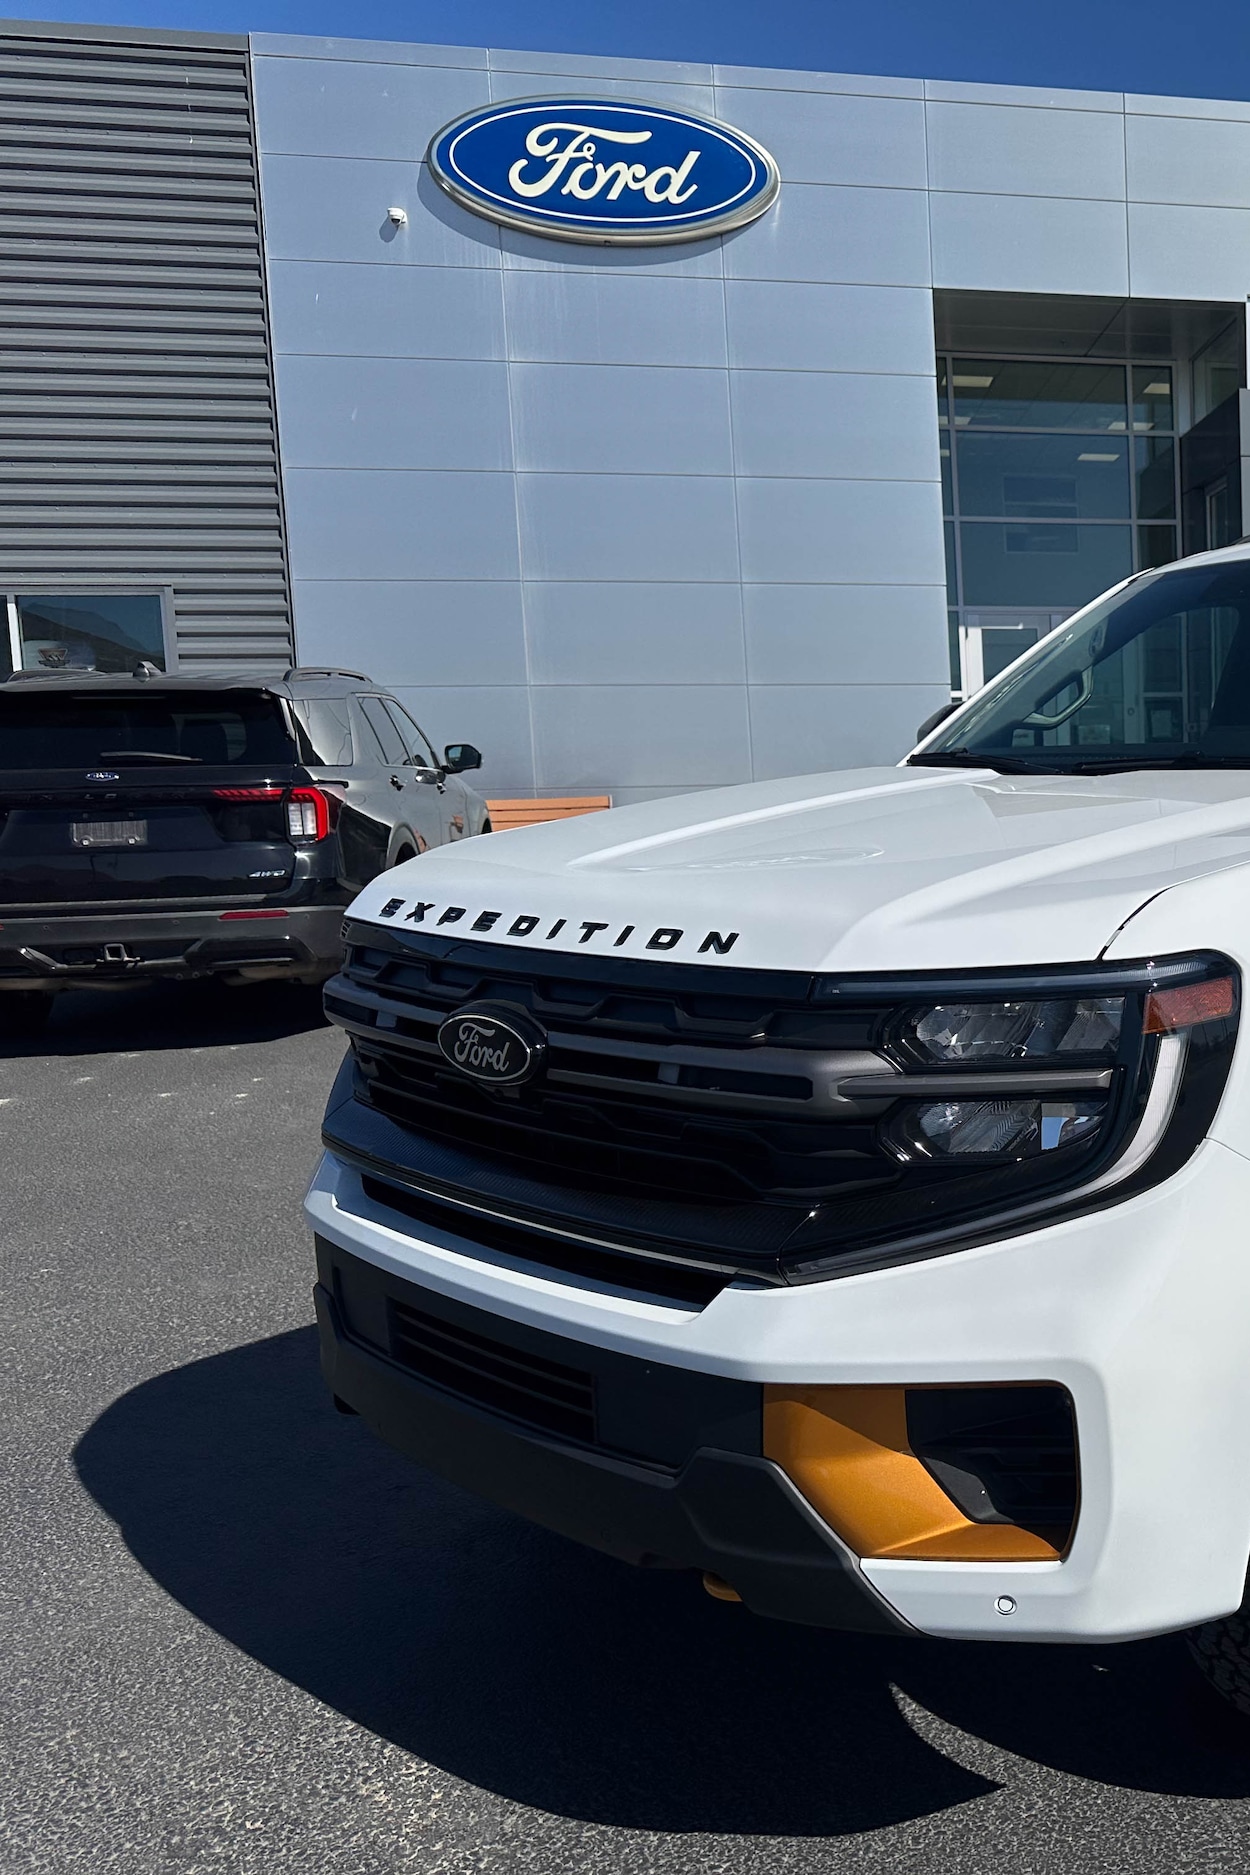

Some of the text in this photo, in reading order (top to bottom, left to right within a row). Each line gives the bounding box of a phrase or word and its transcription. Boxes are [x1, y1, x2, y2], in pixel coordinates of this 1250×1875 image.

[508, 122, 701, 204] Ford
[379, 898, 740, 954] EXPEDITION
[454, 1022, 511, 1072] Ford
